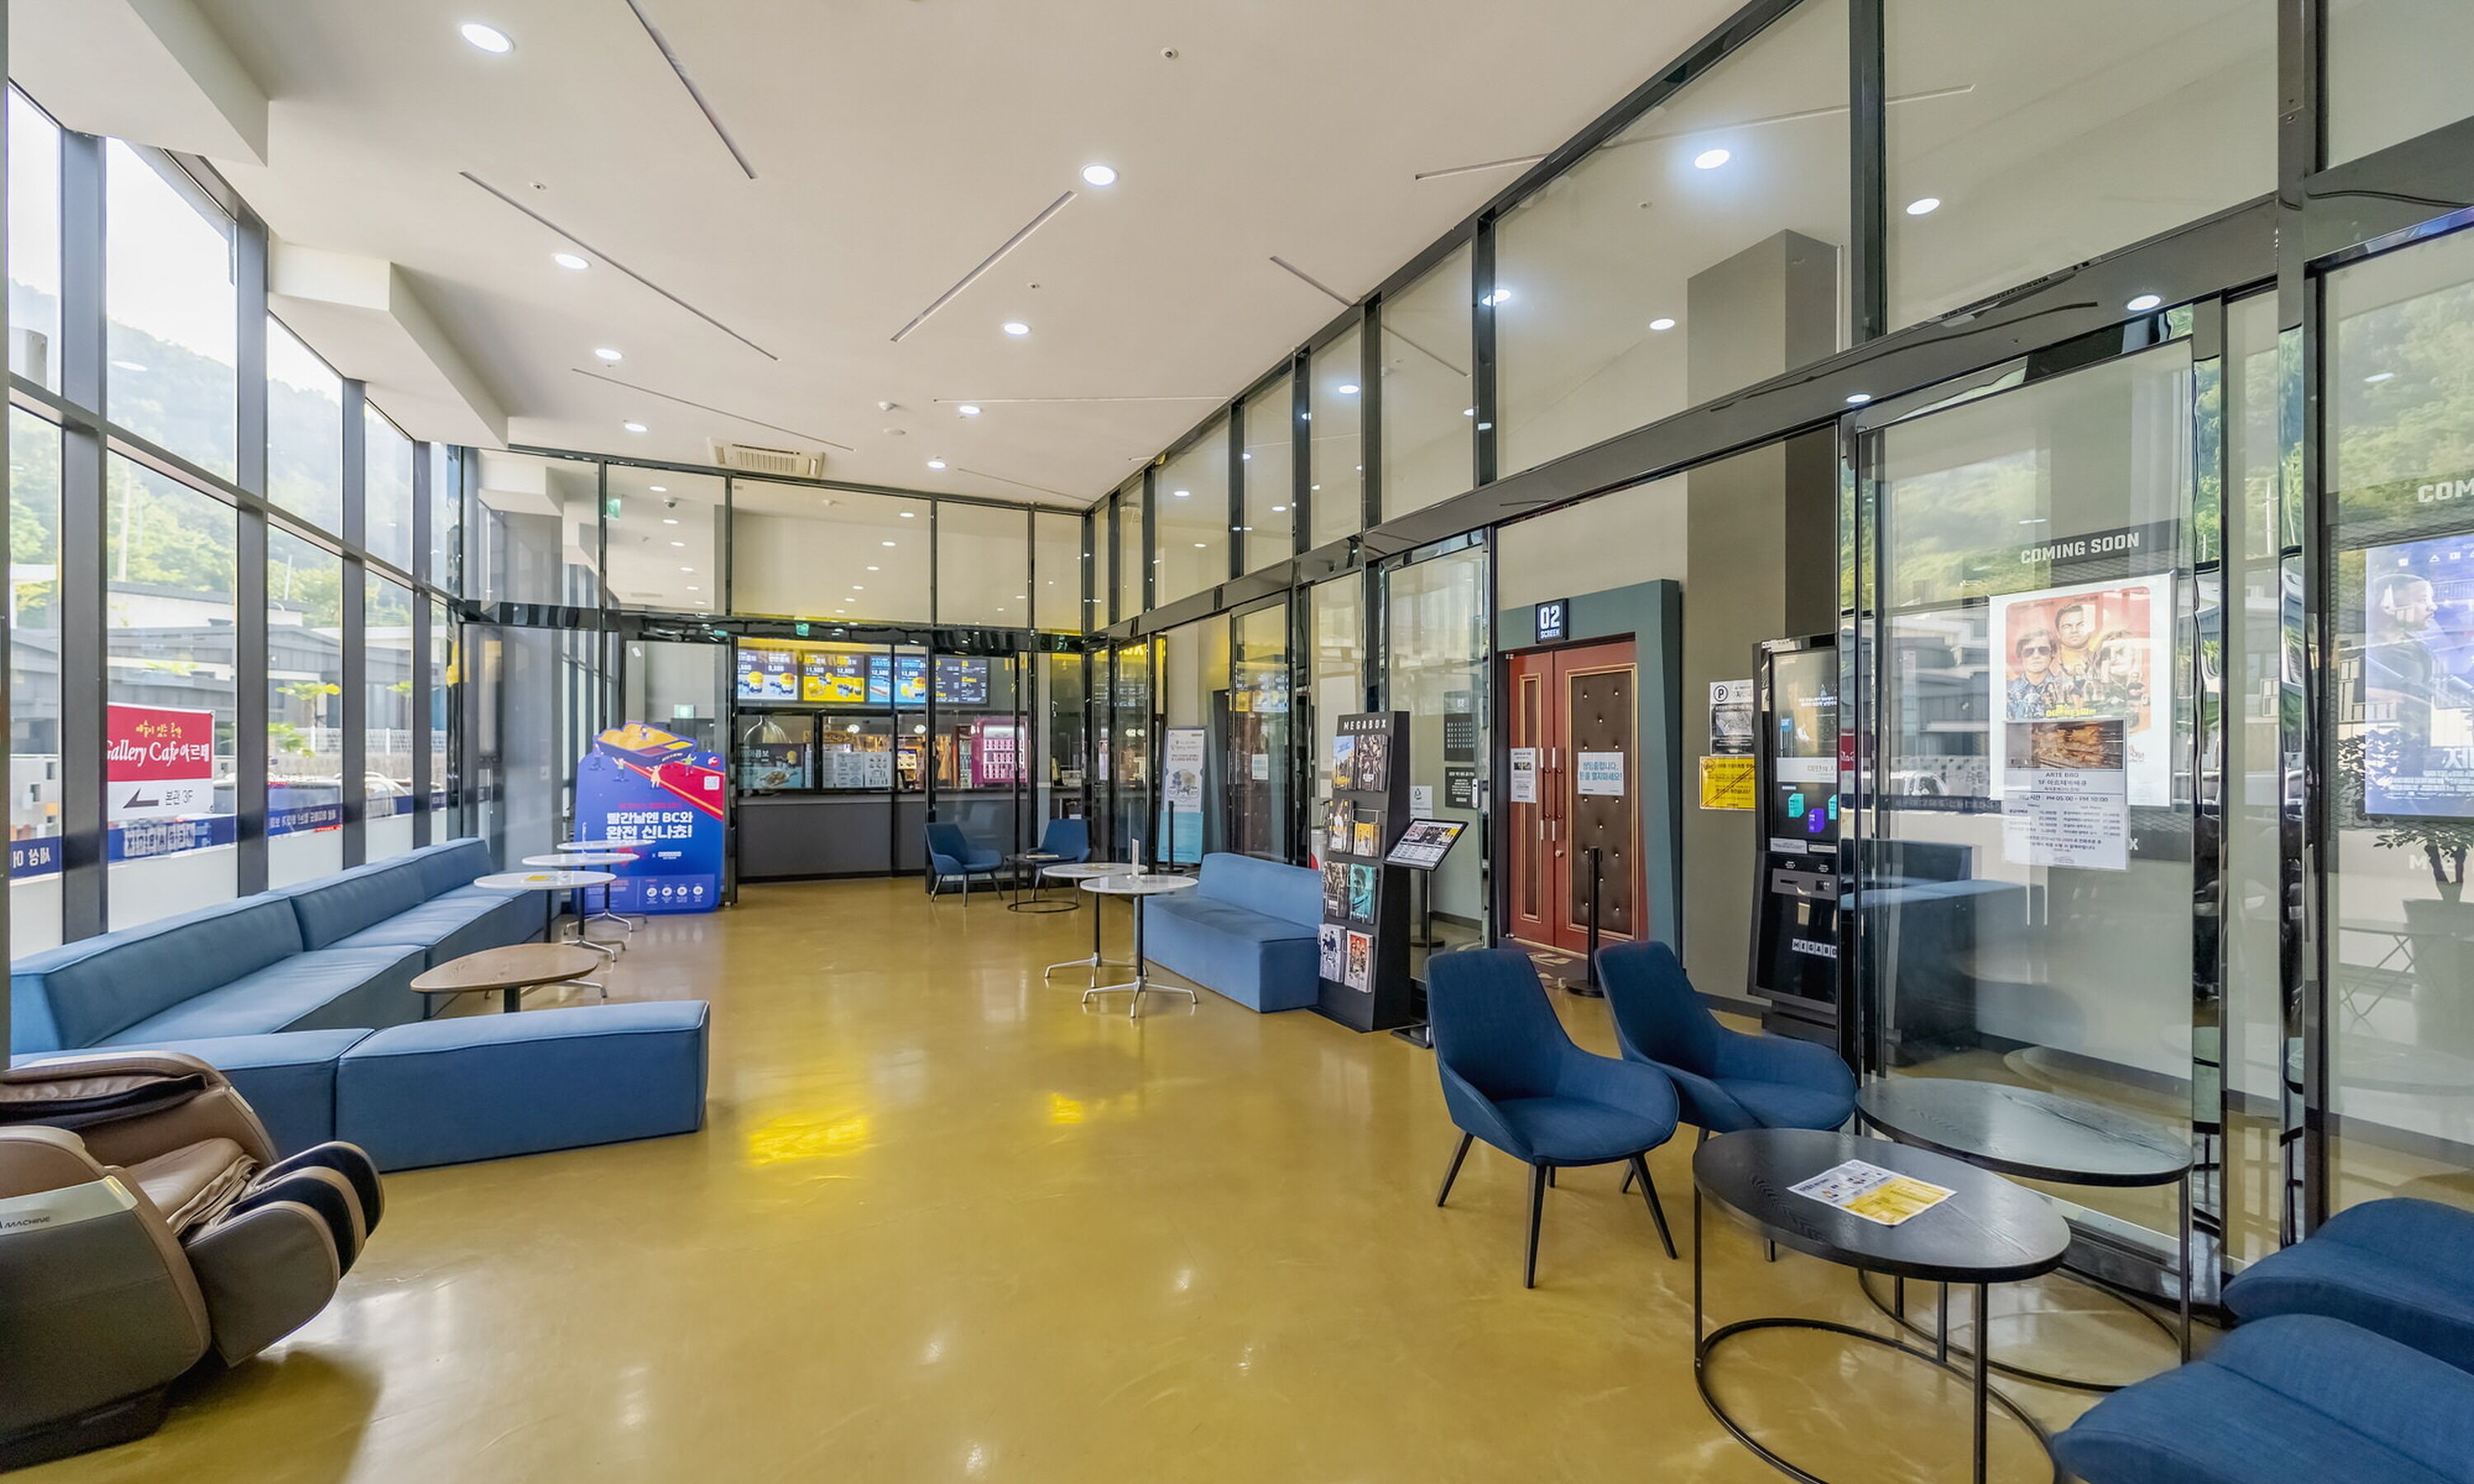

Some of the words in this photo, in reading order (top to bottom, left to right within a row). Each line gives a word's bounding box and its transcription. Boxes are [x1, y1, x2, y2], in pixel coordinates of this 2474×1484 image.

[2020, 541, 2086, 564] COMING
[2091, 532, 2140, 554] SOON
[1540, 605, 1560, 630] 02
[1540, 629, 1560, 639] SCREEN
[1343, 718, 1387, 731] MEGABOX
[107, 739, 148, 768] Gallery
[148, 740, 179, 767] Cafe
[606, 811, 659, 824] 빨간날엔
[662, 810, 693, 824] BC와
[605, 825, 637, 839] 완전
